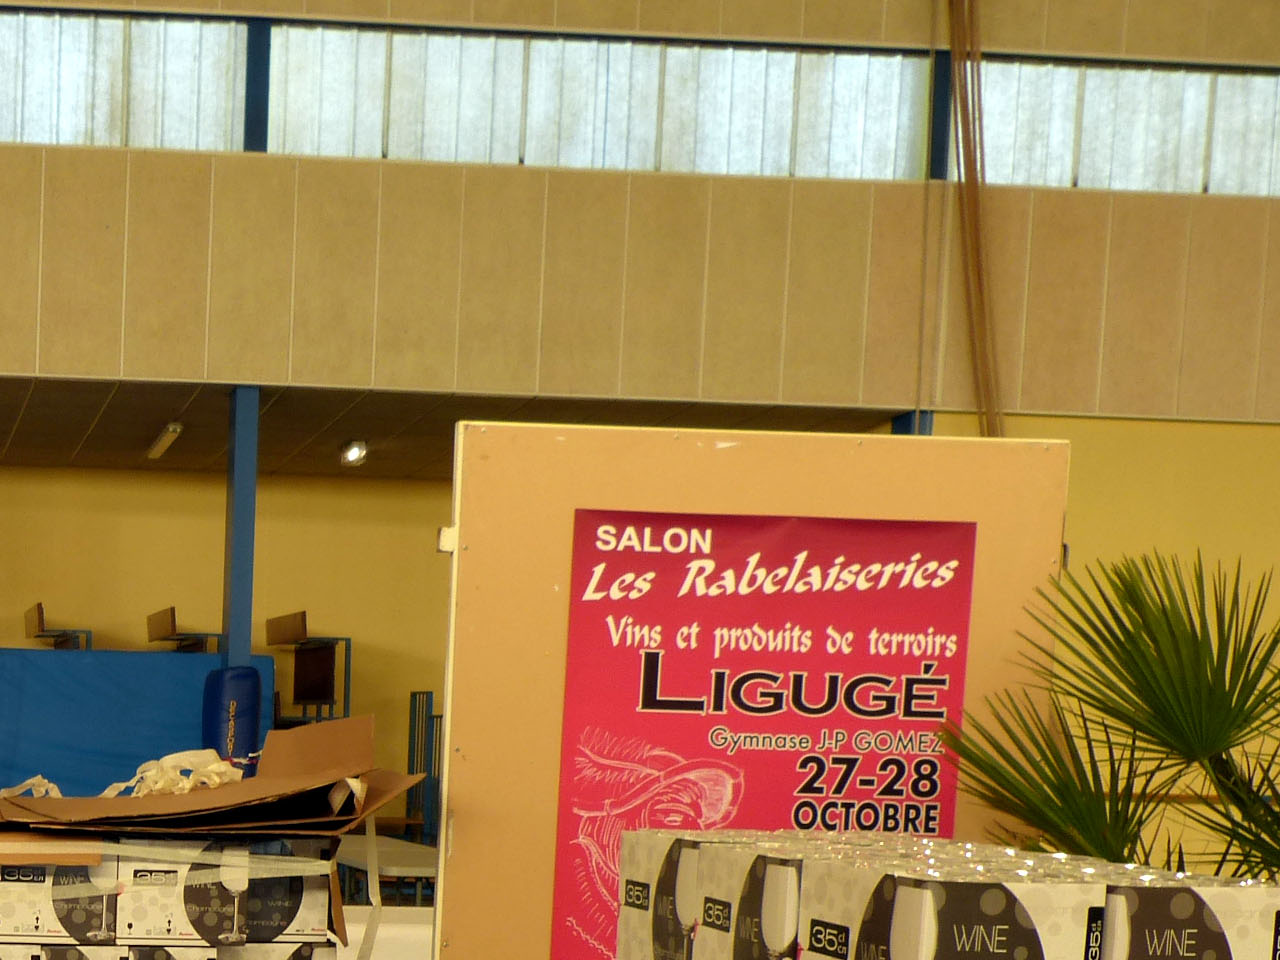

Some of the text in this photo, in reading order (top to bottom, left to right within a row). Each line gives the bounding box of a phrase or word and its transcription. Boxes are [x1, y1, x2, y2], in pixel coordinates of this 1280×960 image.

[595, 525, 712, 554] SALON
[582, 550, 960, 601] Les Rabelaiseries
[605, 614, 958, 658] Vins et produits de terroirs
[709, 726, 945, 755] Gymnase J-P GOMEZ
[795, 754, 941, 799] 27-28
[792, 800, 939, 835] OCTOBRE
[953, 924, 1009, 953] WINE
[1145, 929, 1198, 957] WINE
